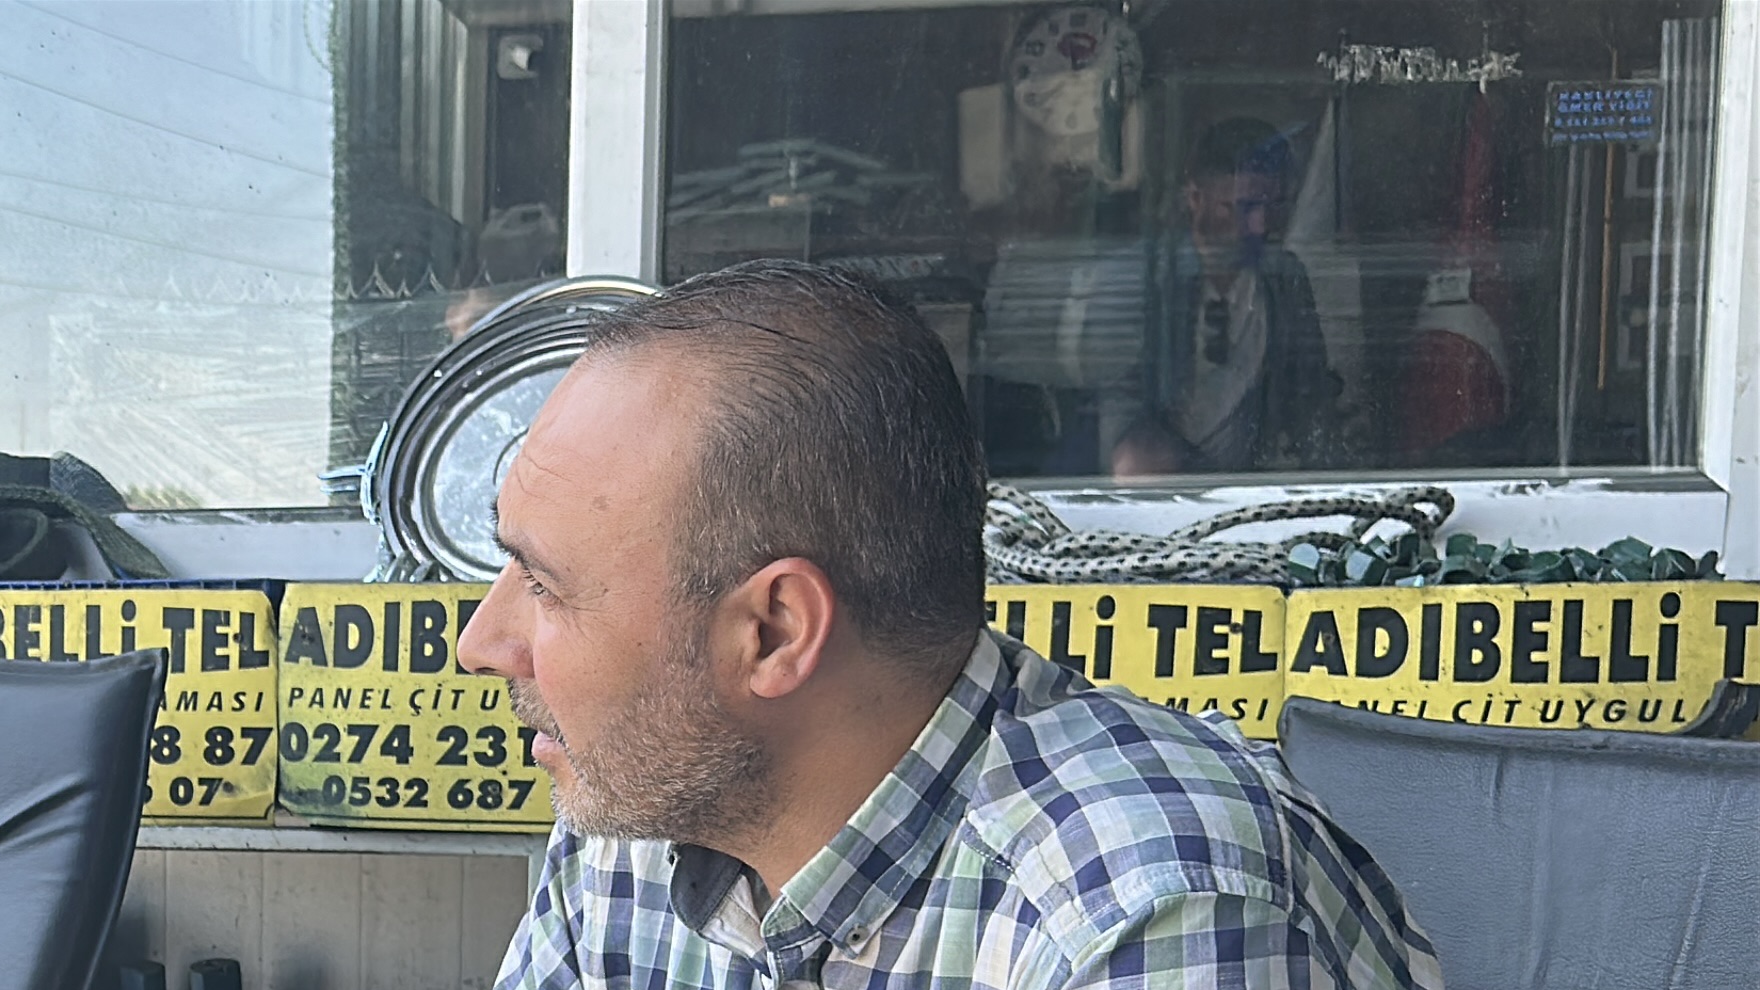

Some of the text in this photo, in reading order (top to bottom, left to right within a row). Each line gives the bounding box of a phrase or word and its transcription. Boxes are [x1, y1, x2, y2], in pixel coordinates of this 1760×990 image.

[162, 606, 270, 674] TEL
[1147, 604, 1278, 678] TEL
[287, 686, 393, 711] PANEL
[409, 682, 466, 716] ÇİT
[1539, 698, 1709, 723] UYGUL
[203, 725, 274, 767] 87
[280, 721, 538, 768] 0274 231
[169, 776, 224, 807] 07
[321, 774, 536, 811] 0532 687
